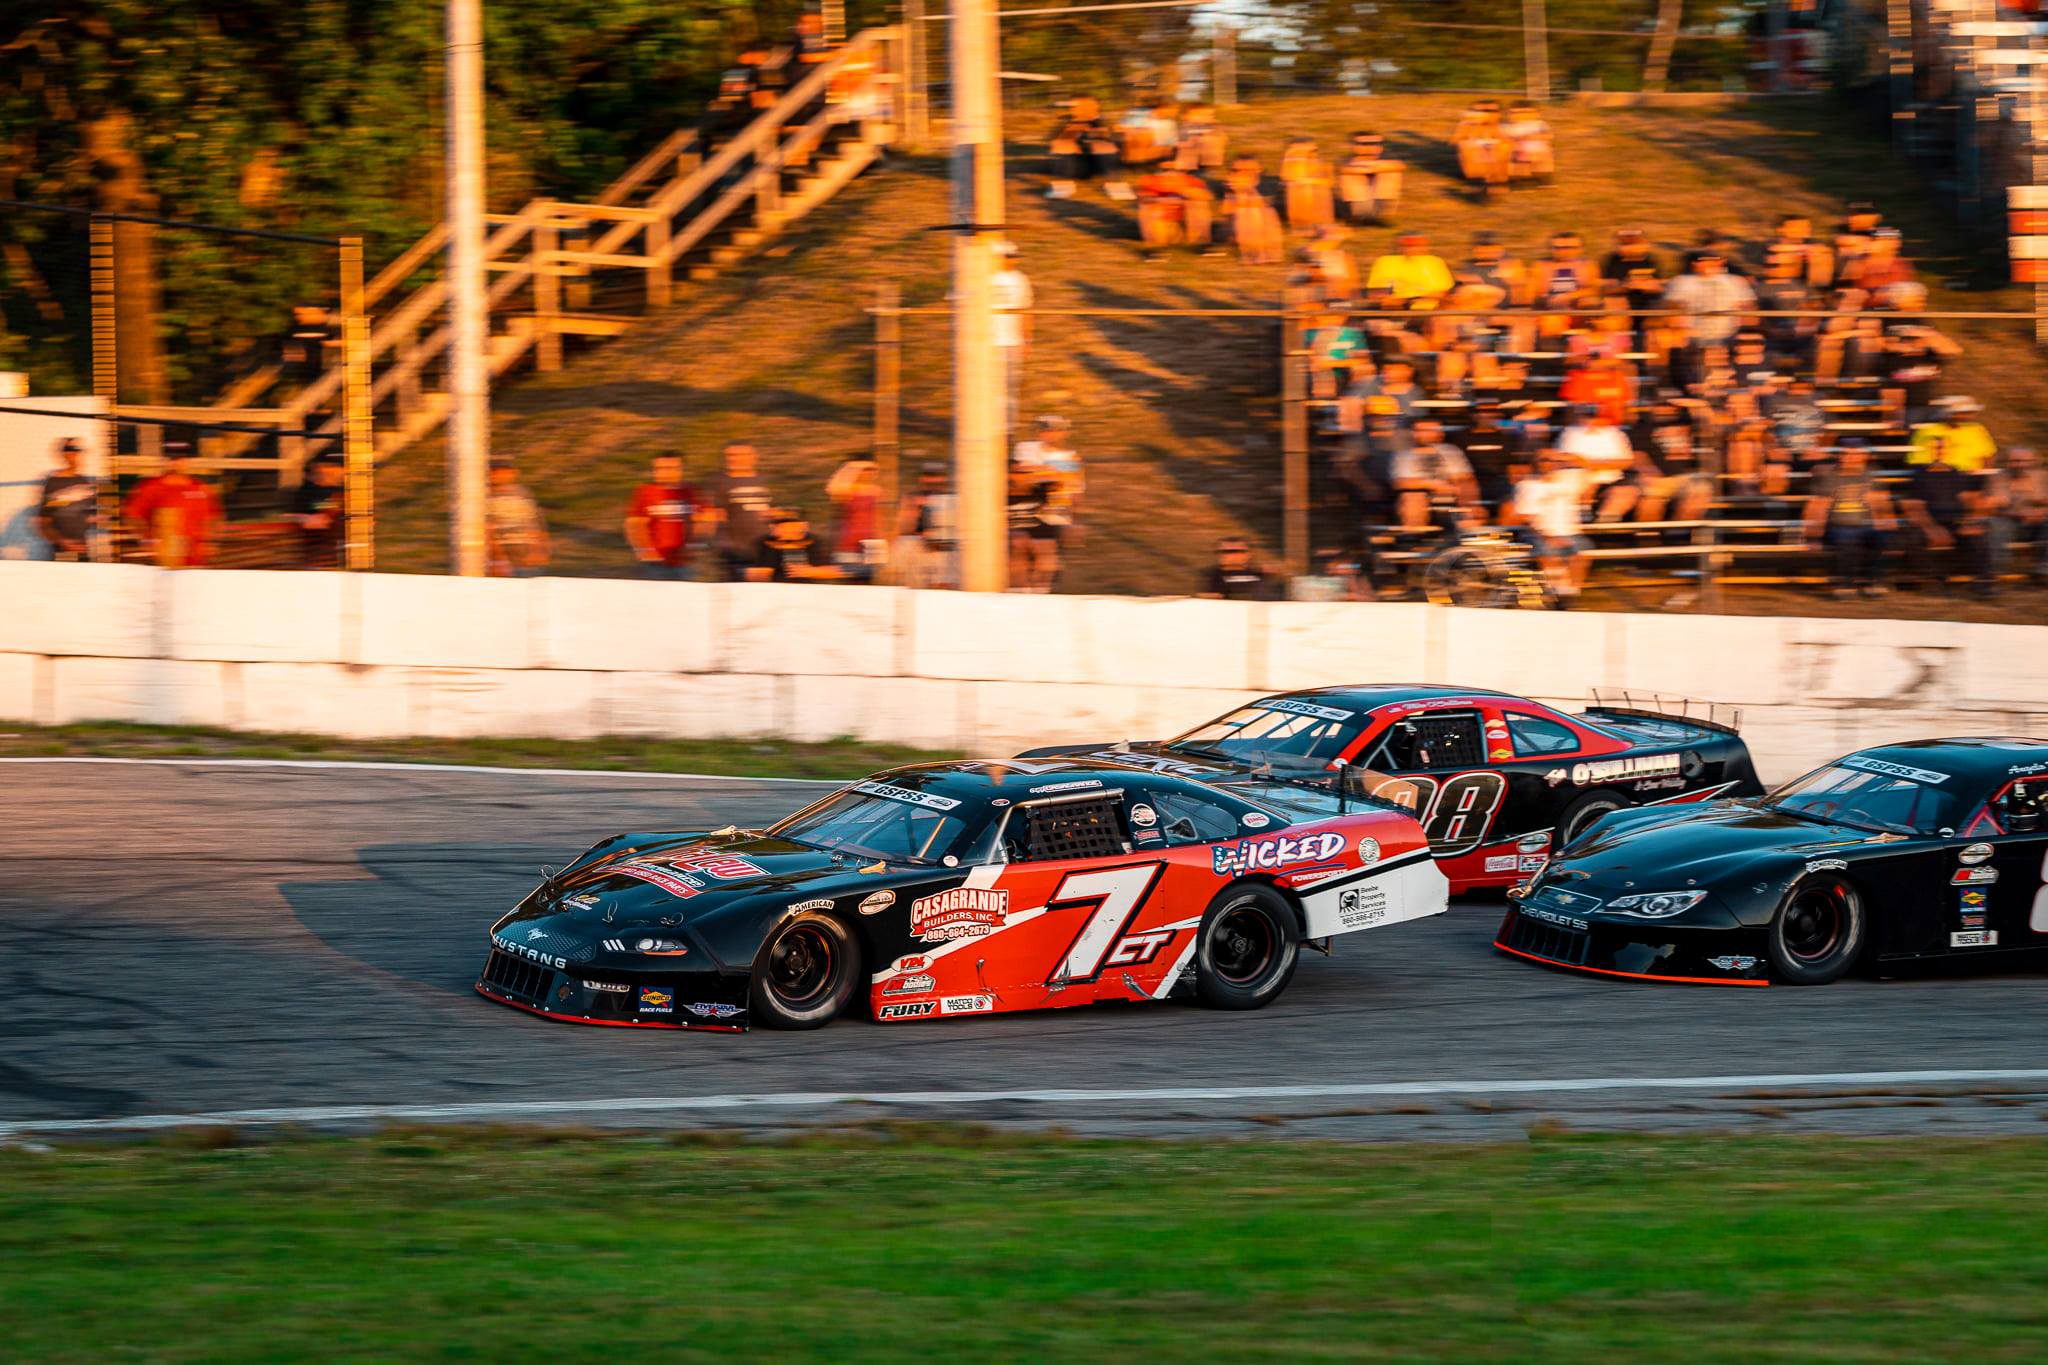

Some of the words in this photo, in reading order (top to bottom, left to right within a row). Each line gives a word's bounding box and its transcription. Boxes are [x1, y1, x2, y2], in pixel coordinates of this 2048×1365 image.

[1272, 701, 1323, 714] GSPSS
[1863, 760, 1916, 776] GSPSS
[874, 785, 928, 801] GSPSS
[1212, 831, 1346, 878] WICKED
[666, 879, 689, 895] PARTS
[792, 899, 834, 915] AMERICAN
[911, 888, 1007, 925] CASAGRANDE
[923, 911, 974, 928] BUILDERS,
[975, 912, 995, 921] INC.
[1045, 859, 1168, 987] 7
[1519, 905, 1573, 926] CHEVROLET
[1571, 918, 1589, 930] SS
[492, 936, 567, 969] MUSTANG
[1105, 930, 1175, 968] CT
[879, 1001, 937, 1019] FURY
[946, 998, 973, 1006] MATCO
[947, 1003, 973, 1012] TOOLS
